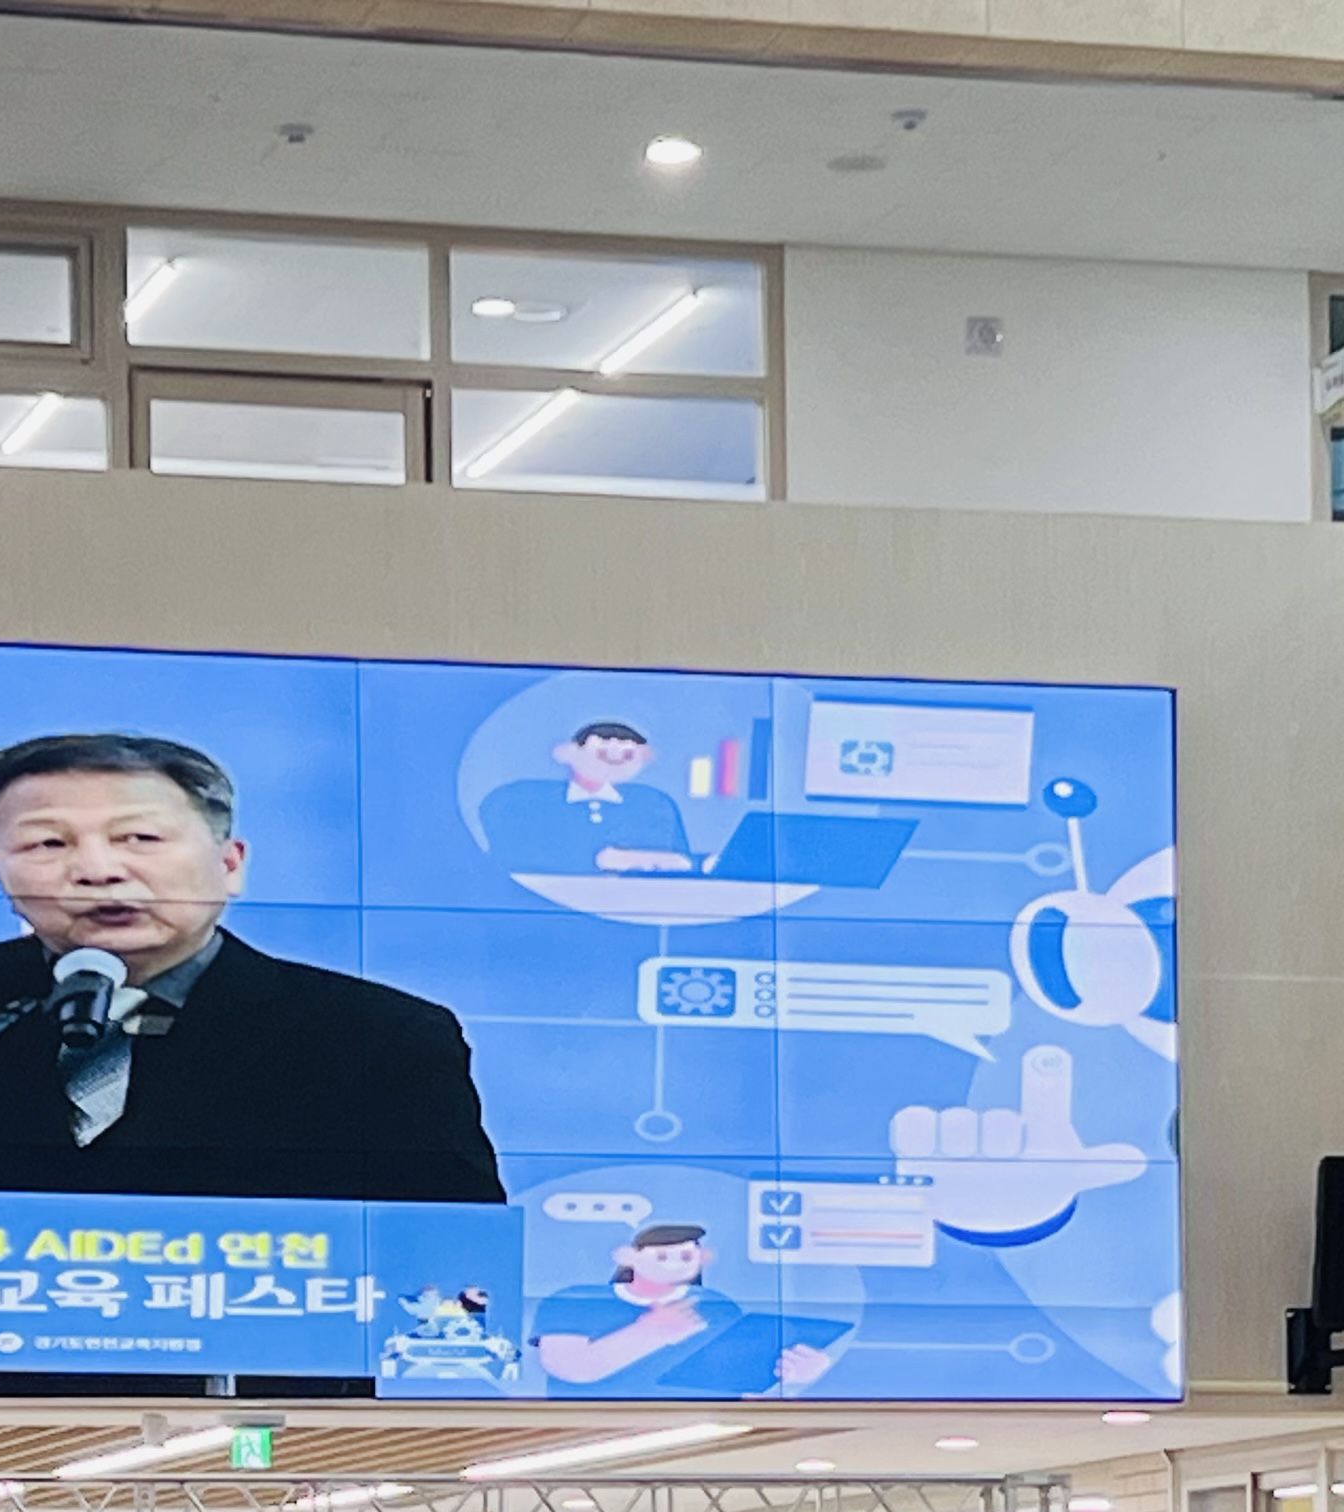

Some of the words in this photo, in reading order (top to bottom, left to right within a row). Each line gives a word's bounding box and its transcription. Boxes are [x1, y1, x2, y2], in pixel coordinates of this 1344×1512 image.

[26, 1228, 203, 1264] AIDEd
[218, 1231, 330, 1269] 연천
[143, 1271, 386, 1323] 페스타
